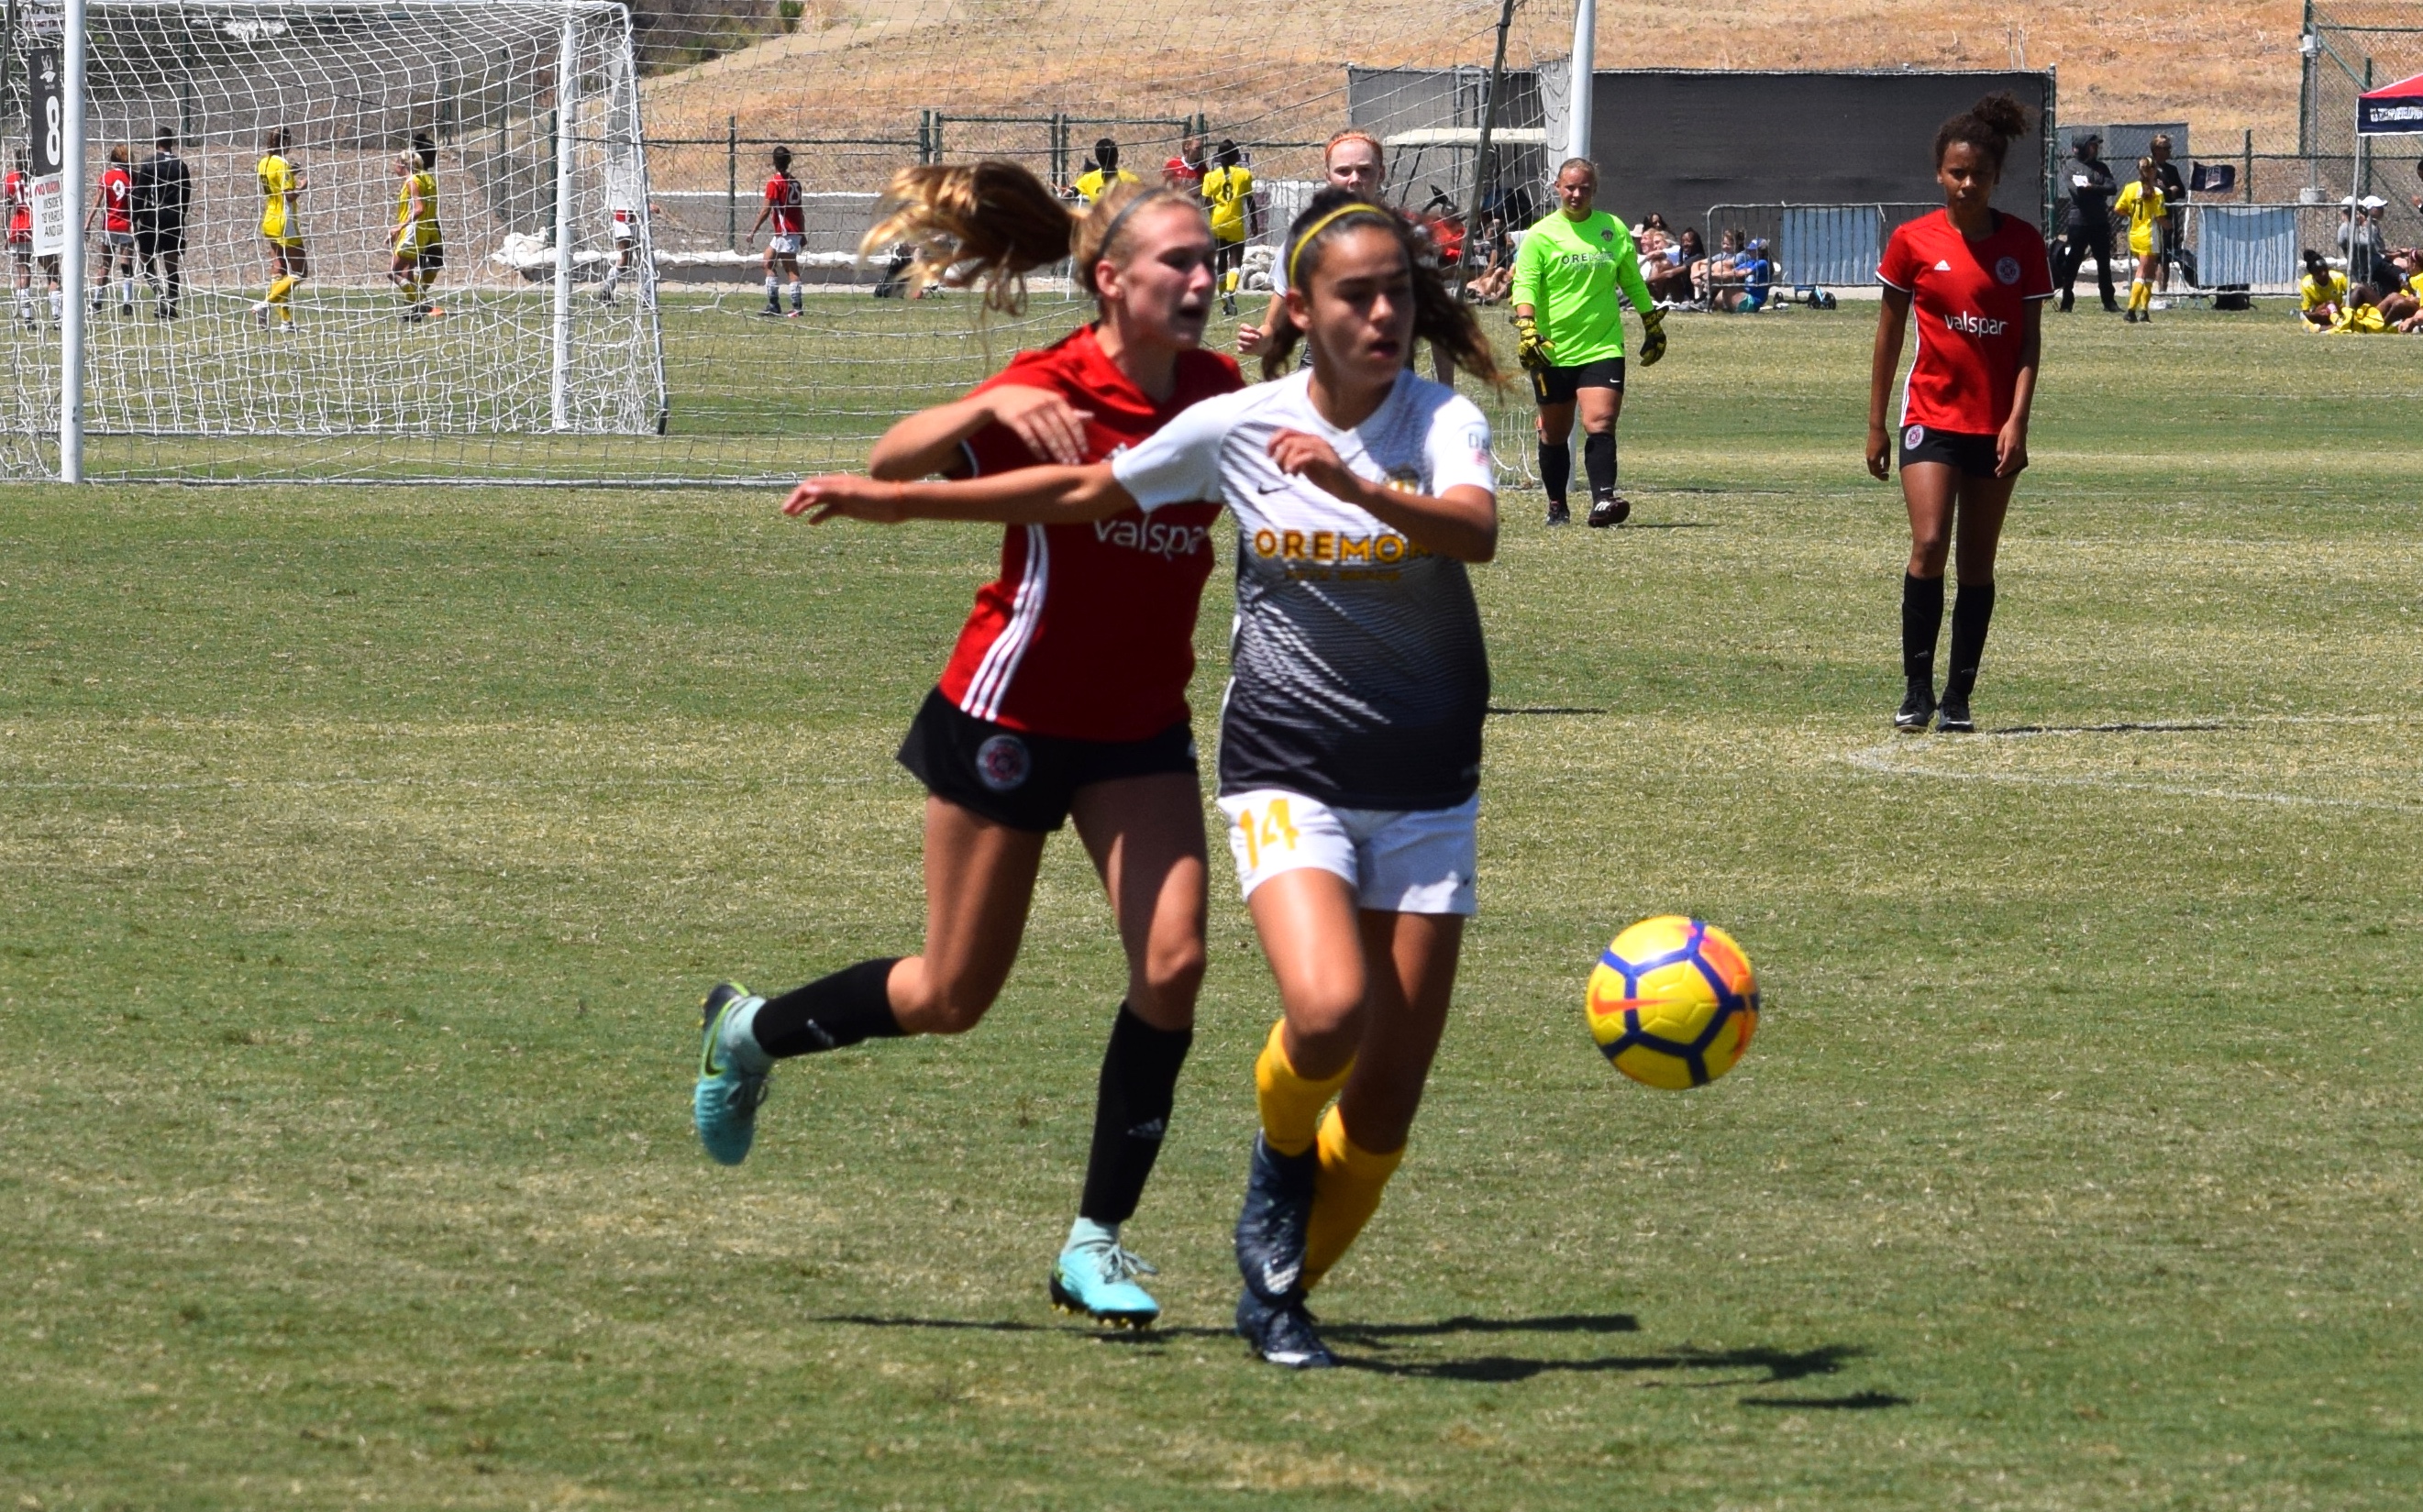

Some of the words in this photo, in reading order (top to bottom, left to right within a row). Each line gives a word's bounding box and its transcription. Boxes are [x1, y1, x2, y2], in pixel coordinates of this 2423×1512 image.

[46, 95, 61, 166] 8
[113, 179, 126, 202] 9
[1223, 182, 1234, 202] 8
[1944, 310, 2008, 337] valspar
[1536, 372, 1548, 397] 1
[1239, 798, 1300, 870] 14
